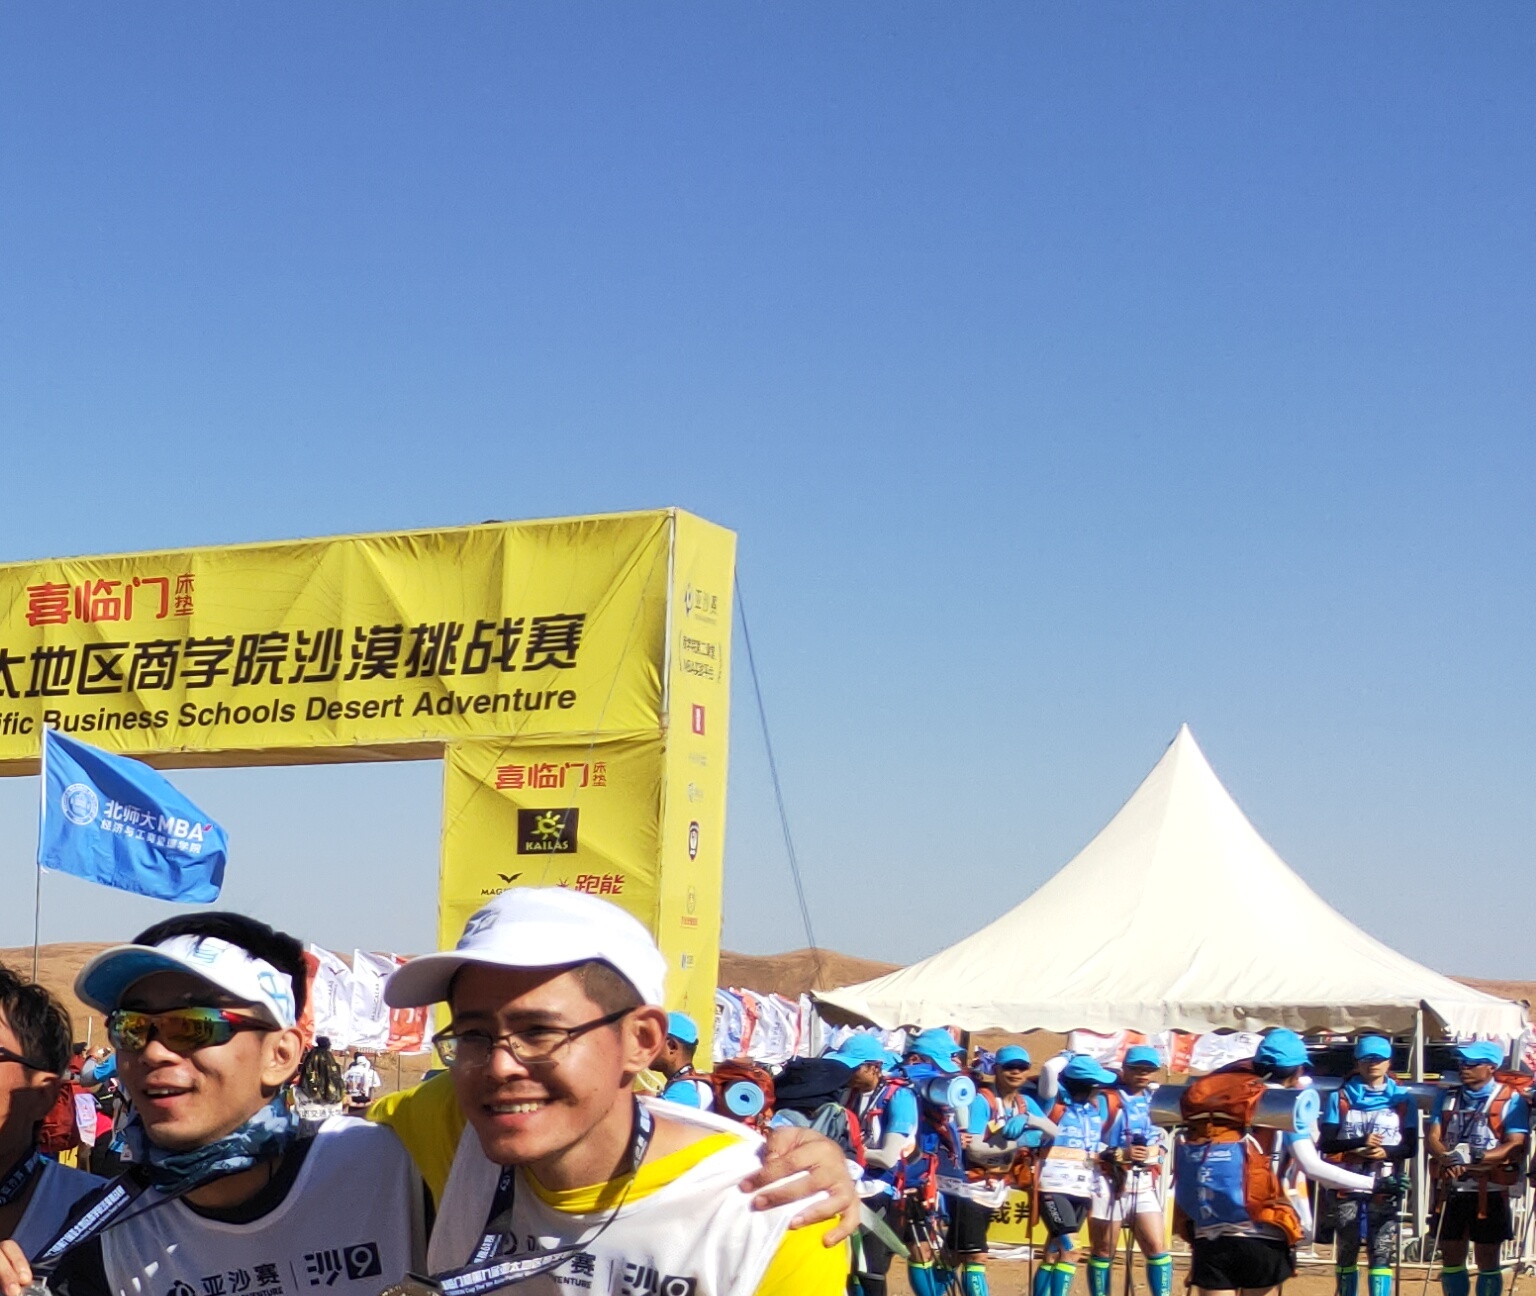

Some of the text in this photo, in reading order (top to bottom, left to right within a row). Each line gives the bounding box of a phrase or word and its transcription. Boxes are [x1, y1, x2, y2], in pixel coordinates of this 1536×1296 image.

[27, 576, 170, 627] 喜临门
[174, 573, 195, 616] 床垫
[44, 705, 169, 733] Business
[178, 697, 295, 726] Schools
[306, 694, 403, 723] Desert
[412, 688, 576, 718] Adventure
[496, 763, 588, 789] 喜临门
[104, 800, 204, 841] 北师大MBA
[526, 841, 568, 850] KAILAS
[575, 874, 625, 894] 跑能
